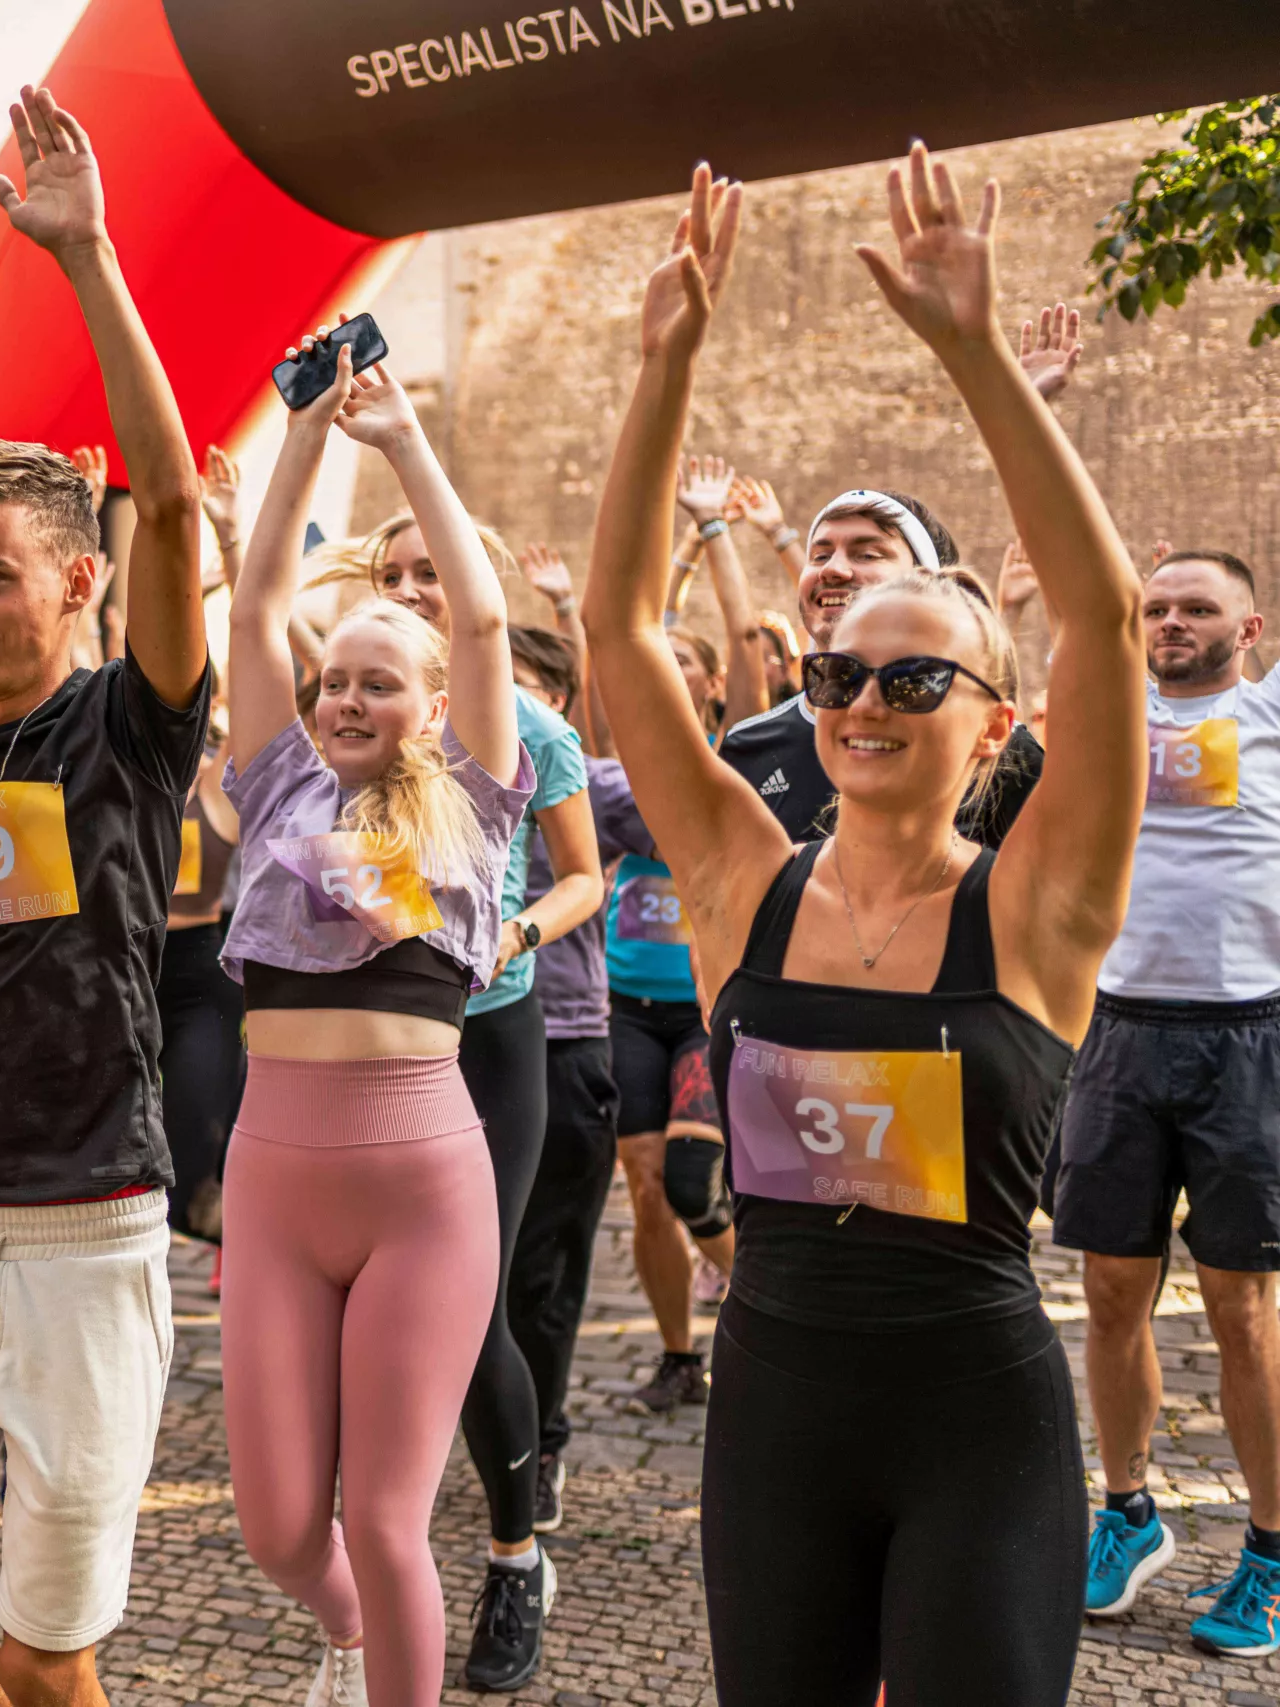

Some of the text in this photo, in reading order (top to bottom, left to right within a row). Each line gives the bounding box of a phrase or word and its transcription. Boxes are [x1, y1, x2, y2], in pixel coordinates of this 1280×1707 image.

[347, 6, 600, 98] SPECIALISTA
[601, 0, 675, 42] NA
[1150, 741, 1202, 778] 13
[19, 891, 71, 917] RUN
[320, 863, 393, 911] 52
[395, 911, 437, 936] RUN
[640, 893, 681, 924] 23
[738, 1046, 891, 1087] FUN RELAX
[795, 1097, 894, 1159] 37
[813, 1176, 960, 1216] SAFE RUN
